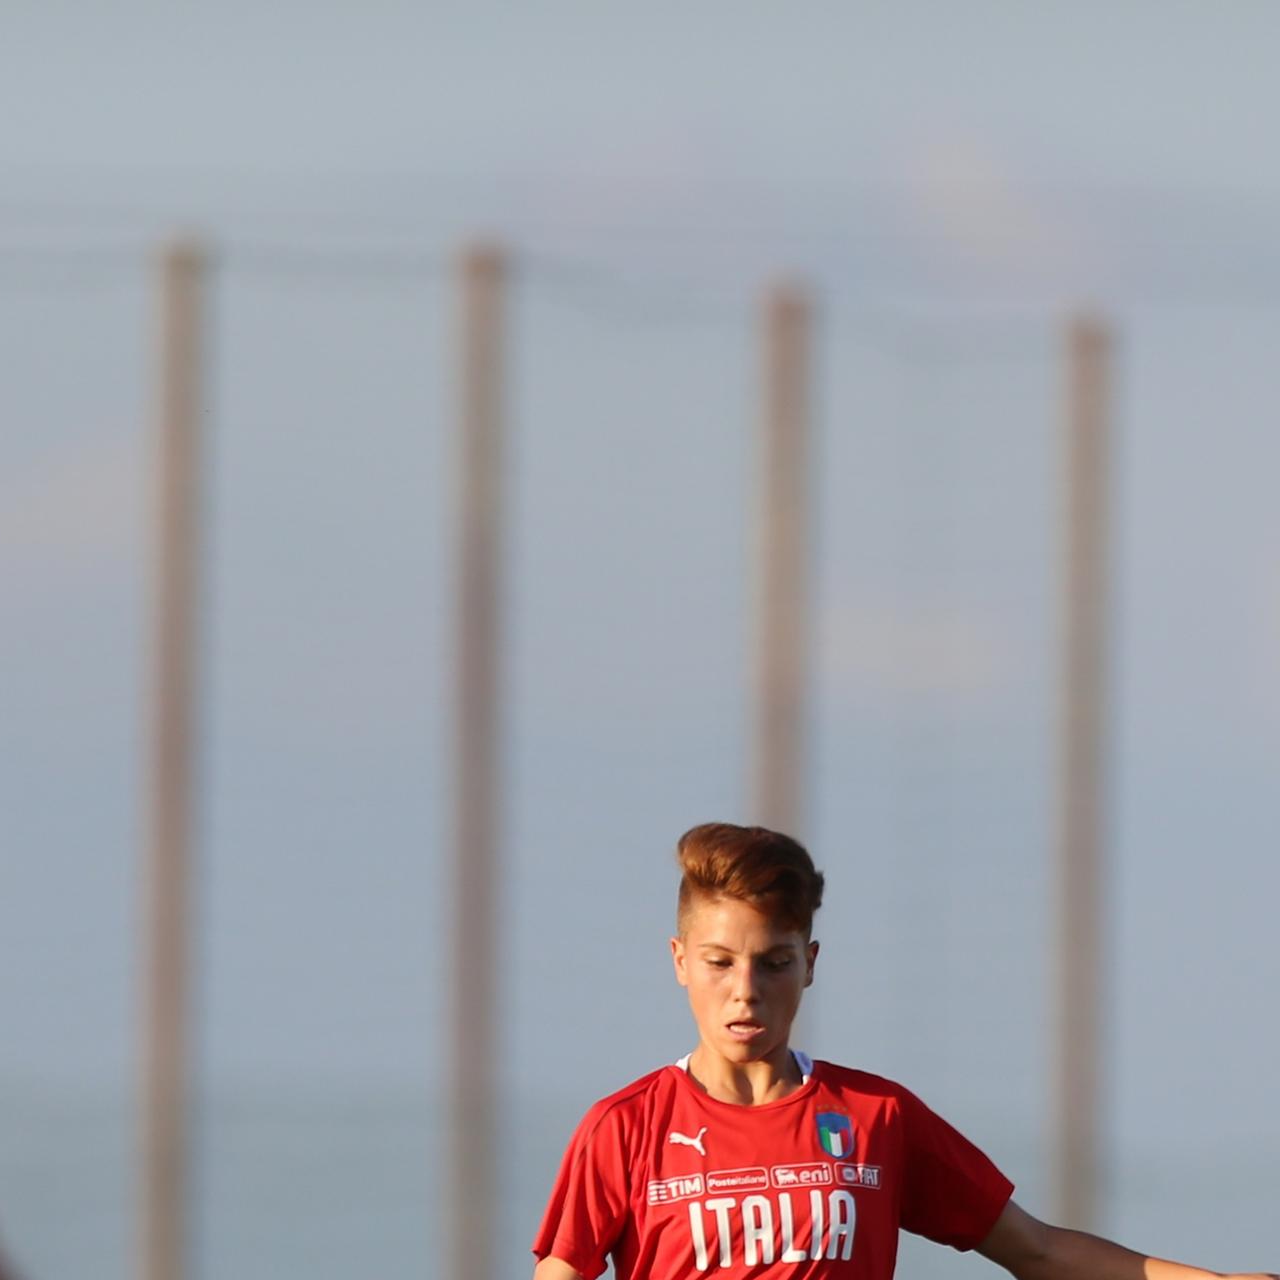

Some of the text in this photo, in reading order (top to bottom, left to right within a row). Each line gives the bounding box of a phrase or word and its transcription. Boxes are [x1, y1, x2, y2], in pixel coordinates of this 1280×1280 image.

[668, 1177, 702, 1197] TIM
[800, 1164, 829, 1182] eni
[857, 1167, 879, 1186] FIAT
[688, 1189, 857, 1272] ITALIA
